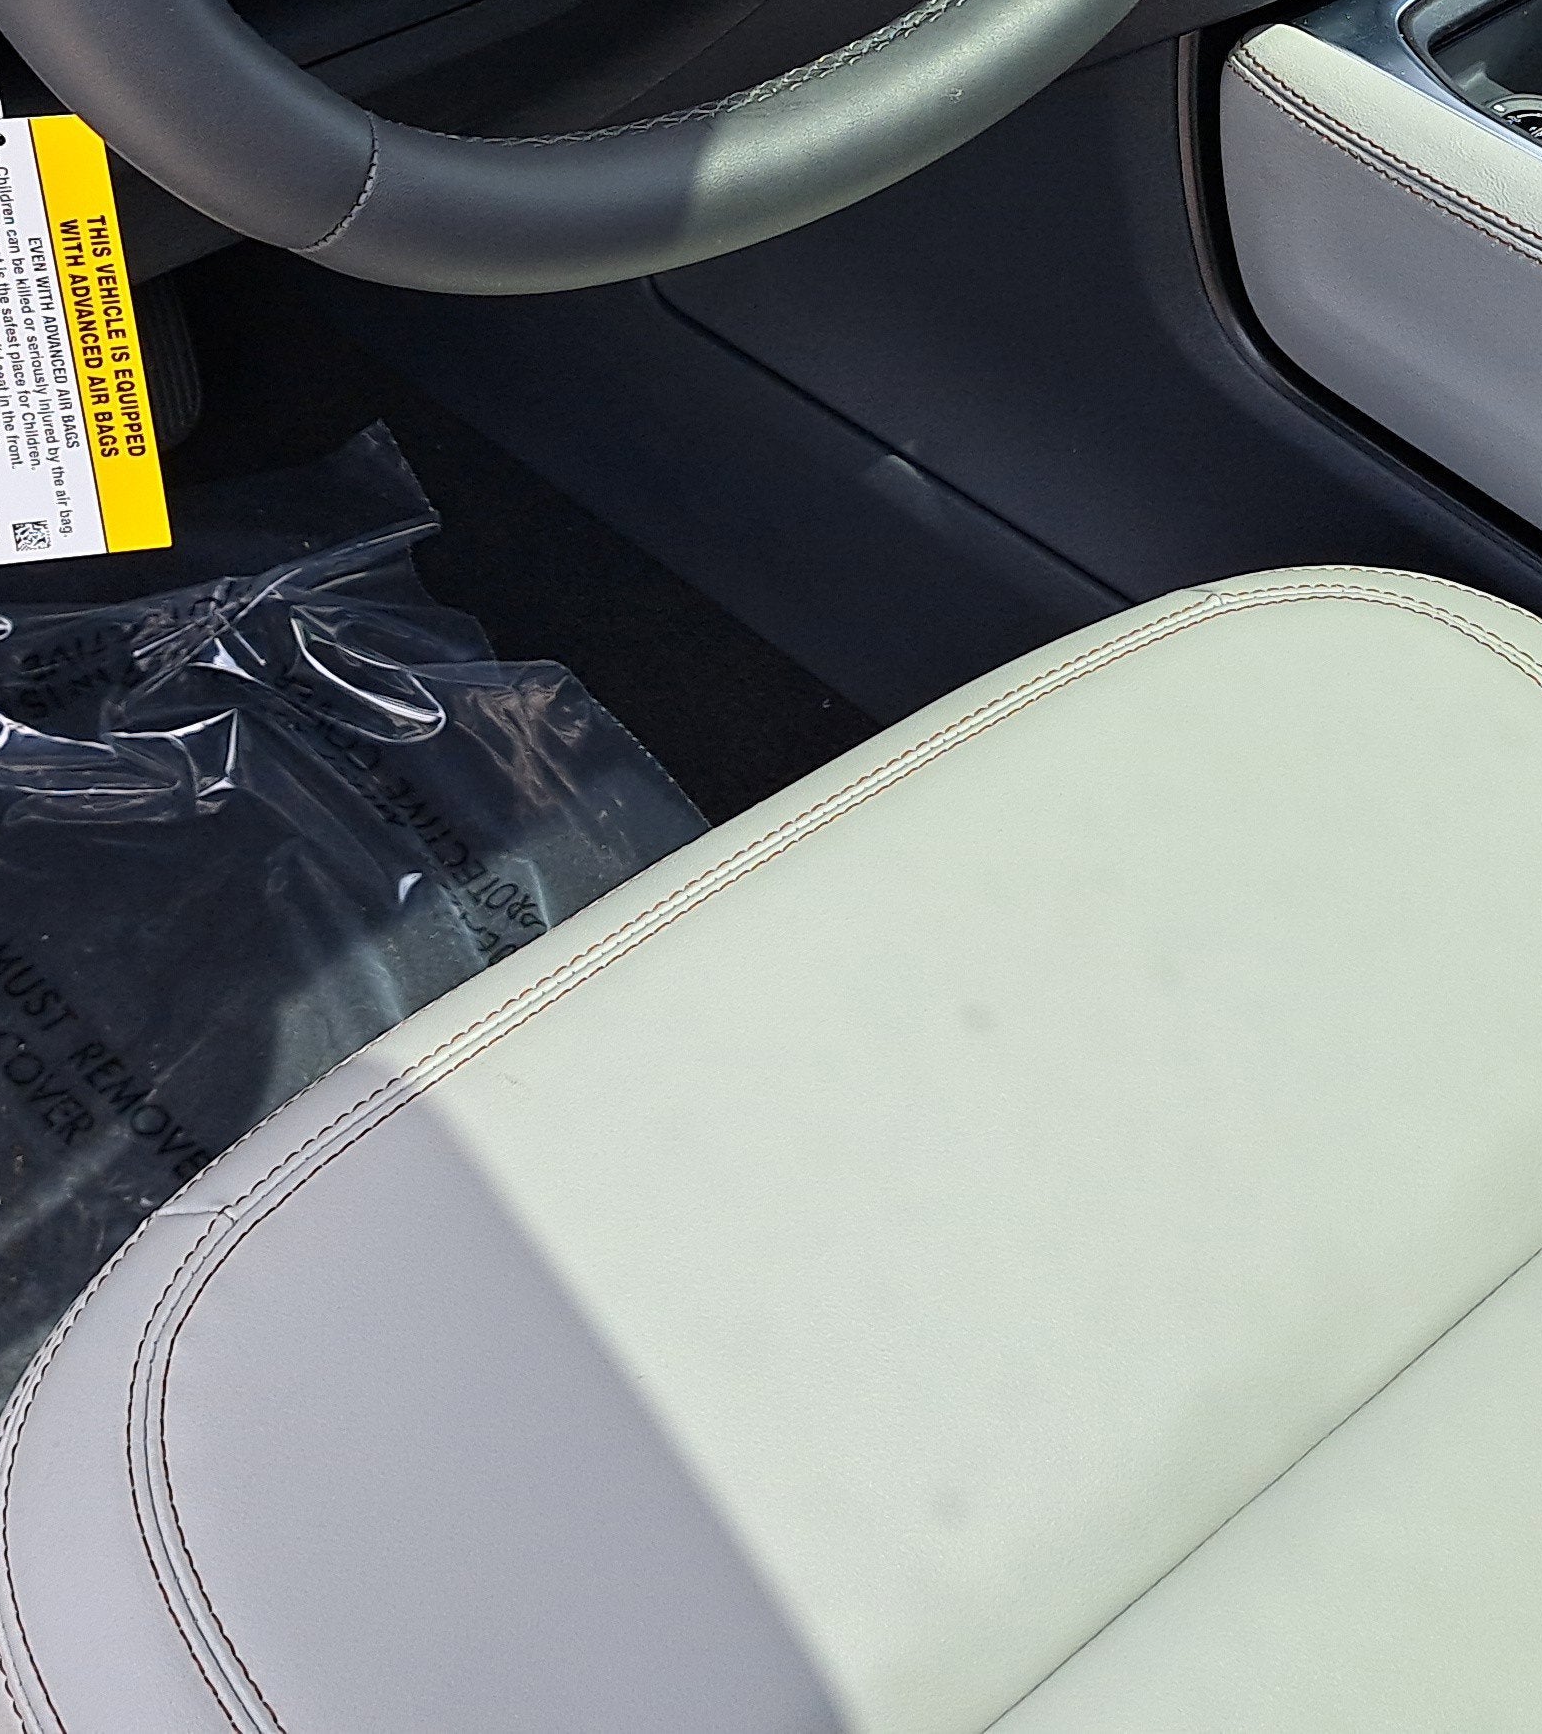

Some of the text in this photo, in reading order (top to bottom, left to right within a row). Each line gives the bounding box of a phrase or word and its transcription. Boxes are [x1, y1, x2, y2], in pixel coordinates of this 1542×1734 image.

[6, 229, 21, 254] can
[11, 257, 26, 275] be
[15, 277, 36, 314] killed
[1, 307, 22, 349] safest
[23, 317, 36, 332] or
[59, 218, 120, 458] WITH ADVANCED AIR BAGS
[86, 214, 147, 457] THIS VEHICLE IS EQUIPPED
[27, 237, 80, 449] EVEN WITH ADVANCED AIR BAGS
[6, 351, 26, 387] place
[26, 335, 50, 395] seriously
[16, 389, 31, 409] for
[1, 410, 16, 432] the
[37, 398, 60, 444] injured
[6, 434, 24, 470] front.
[21, 412, 41, 471] Children.
[45, 446, 61, 463] by
[51, 465, 65, 487] the
[55, 489, 71, 507] air
[58, 509, 73, 538] bag.
[66, 1034, 214, 1183] REMOVE
